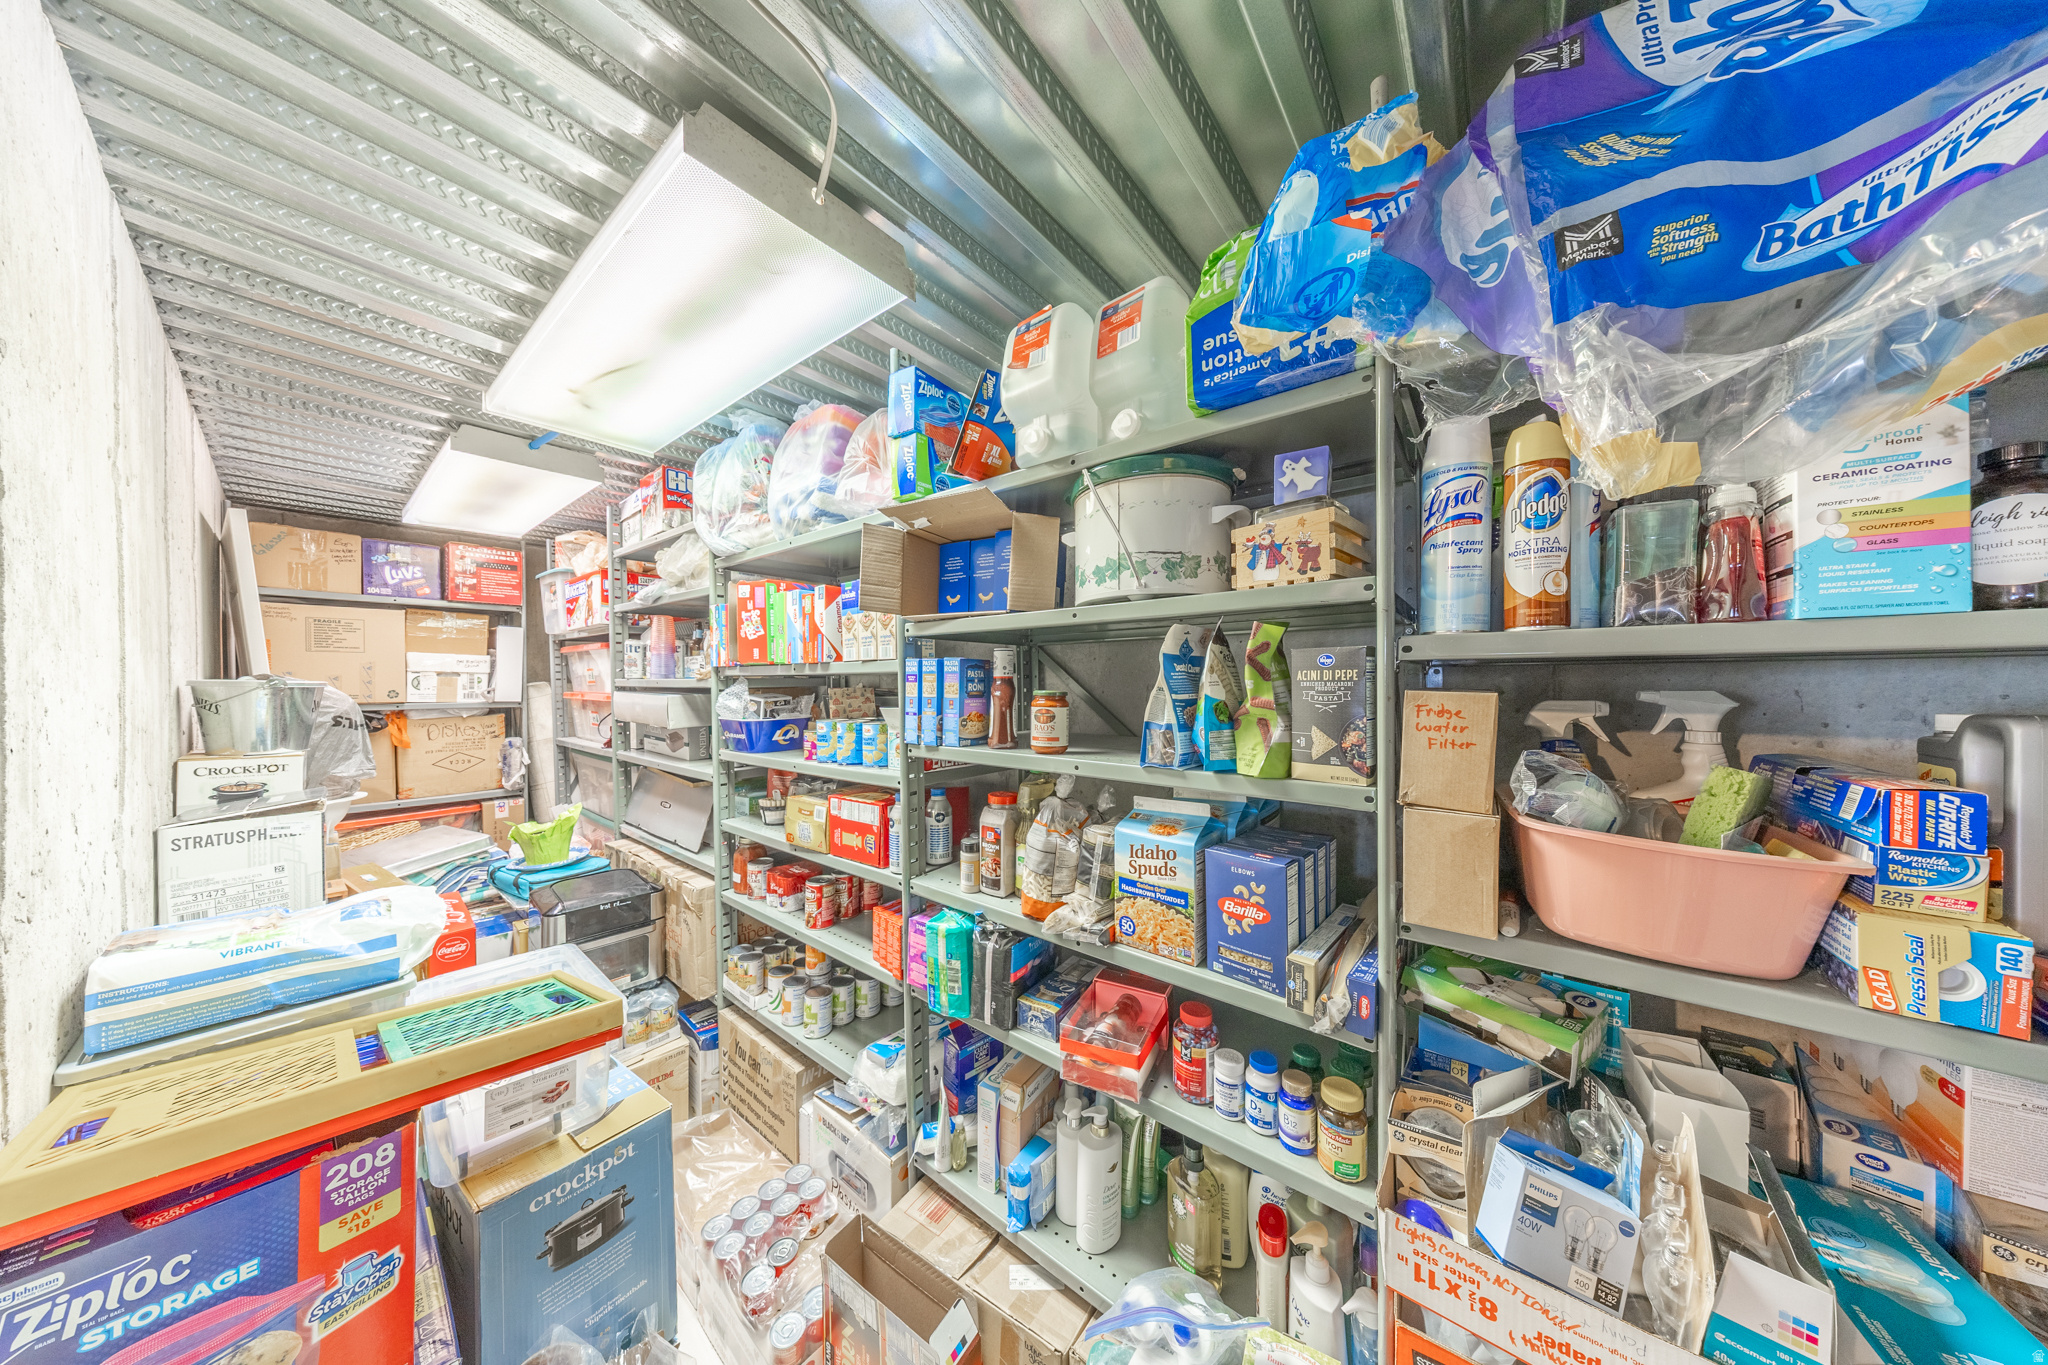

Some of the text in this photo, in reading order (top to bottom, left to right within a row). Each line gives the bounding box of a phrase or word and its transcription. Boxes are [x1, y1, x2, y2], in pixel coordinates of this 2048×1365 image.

[1862, 82, 2026, 188] Ultra Premium
[1653, 214, 1710, 236] Superior
[1757, 182, 1906, 264] Bath
[1651, 223, 1716, 247] Softness
[1661, 232, 1719, 255] Strength
[1562, 236, 1620, 263] Member's
[1678, 245, 1704, 258] need
[1204, 358, 1270, 388] America's
[918, 379, 944, 398] Ziploc
[987, 373, 996, 398] Ziploc
[901, 382, 913, 417] Ziploc
[1886, 436, 1923, 446] Home
[991, 445, 1001, 458] XL
[904, 446, 914, 480] Ziploc
[1846, 453, 1916, 468] MULTI-SURFACE
[1812, 458, 1952, 482] CERAMIC COATING
[1424, 479, 1484, 528] Lysol
[1817, 496, 1882, 508] PROTECT YOUR:
[1510, 492, 1568, 533] pledge
[1852, 506, 1904, 517] STAINLESS
[1970, 502, 2022, 529] leigh
[1432, 522, 1453, 536] 99.9%
[1859, 518, 1934, 532] COUNTERTOPS
[1994, 523, 2032, 534] Meadow
[1430, 540, 1484, 551] Disinfectant
[1515, 537, 1560, 550] EXTRA
[1866, 538, 1898, 546] GLASS
[1974, 540, 2014, 552] liquid
[1508, 546, 1568, 558] MOISTURIZING
[385, 565, 423, 585] Luvs
[1818, 568, 1892, 578] LIQUID RESISTANT
[1849, 578, 1894, 586] CLEANING
[1864, 584, 1919, 592] EFFORTLESS
[968, 670, 984, 678] PASTA
[1174, 663, 1187, 672] Dental
[1297, 670, 1358, 680] ACINI DI PEPE
[968, 682, 984, 692] RONI
[1415, 704, 1466, 721] Fridge
[427, 723, 480, 742] Dishes
[1415, 722, 1469, 734] water
[1428, 736, 1477, 750] Filter
[1925, 799, 1936, 842] WAX PAPER
[1938, 793, 1960, 850] CUT-RITE
[1958, 804, 1974, 842] Reynolds
[864, 834, 876, 854] RITZ
[1128, 844, 1177, 861] Idaho
[938, 852, 950, 860] WATER
[1888, 850, 1950, 866] Reynolds
[1128, 860, 1177, 879] Spuds
[1231, 866, 1256, 877] ELBOWS
[1888, 864, 1938, 878] Plastic
[1912, 861, 1960, 874] KITCHENS
[1888, 872, 1928, 886] Wrap
[1122, 883, 1185, 906] HASHBROWN POTATOES
[1881, 890, 1914, 902] 225
[1934, 896, 1968, 906] Built-in
[1224, 900, 1264, 920] Barilla
[1880, 900, 1897, 908] SQ
[1924, 900, 1944, 908] Slide
[1122, 920, 1134, 932] 50
[220, 941, 282, 958] VIBRANT
[1904, 933, 1926, 966] Seal
[2000, 947, 2024, 972] 140
[98, 981, 170, 998] INSTRUCTIONS:
[1872, 969, 1897, 1010] GLAD
[2006, 988, 2017, 1005] VALUE
[2021, 981, 2030, 1010] ÉCONOMIQUE
[1360, 998, 1368, 1018] Barilla
[975, 1043, 988, 1054] CLEAR
[734, 1039, 747, 1062] You
[748, 1054, 769, 1083] can...
[1946, 1068, 1961, 1082] LED
[1948, 1084, 1956, 1094] 13
[753, 1092, 786, 1126] Moving Supplies
[1250, 1101, 1262, 1114] D3
[1433, 1100, 1452, 1108] cristal
[762, 1116, 780, 1138] Location
[1284, 1113, 1298, 1130] B12
[1392, 1120, 1422, 1133] DECORATIVE
[1320, 1126, 1352, 1146] Nature Made
[1326, 1138, 1342, 1152] Iron
[1409, 1136, 1462, 1156] crystal clear
[325, 1142, 396, 1192] 208
[1859, 1154, 1884, 1166] Great
[330, 1167, 391, 1200] STORAGE
[529, 1142, 636, 1212] crockpot
[334, 1177, 387, 1206] GALLON
[1103, 1182, 1116, 1194] Dove
[1529, 1183, 1558, 1201] PHILIPS
[1851, 1177, 1902, 1198] Lighting Facts
[348, 1190, 374, 1207] BAGS
[338, 1200, 384, 1230] SAVE
[1518, 1215, 1542, 1233] 40W
[10, 1240, 44, 1254] FREEZER
[1882, 1208, 1957, 1281] ecosmart
[1413, 1248, 1480, 1290] letter size
[1438, 1244, 1490, 1282] Camera,
[308, 1256, 402, 1324] Stay Open
[1444, 1278, 1462, 1300] x
[1574, 1278, 1590, 1291] 400
[10, 1254, 192, 1352] Ziploc
[77, 1258, 260, 1353] STORAGE
[324, 1281, 391, 1330] EASY FILLING
[1598, 1290, 1618, 1304] $4.82
[584, 1294, 622, 1323] kendall's honey
[1292, 1296, 1310, 1328] Dove
[82, 1320, 96, 1330] SEAL
[110, 1308, 125, 1318] BAGS
[34, 1338, 56, 1350] BRAND
[1276, 1343, 1295, 1357] Easter
[1533, 1330, 1602, 1365] paper
[1725, 1336, 1778, 1365] ecosmart
